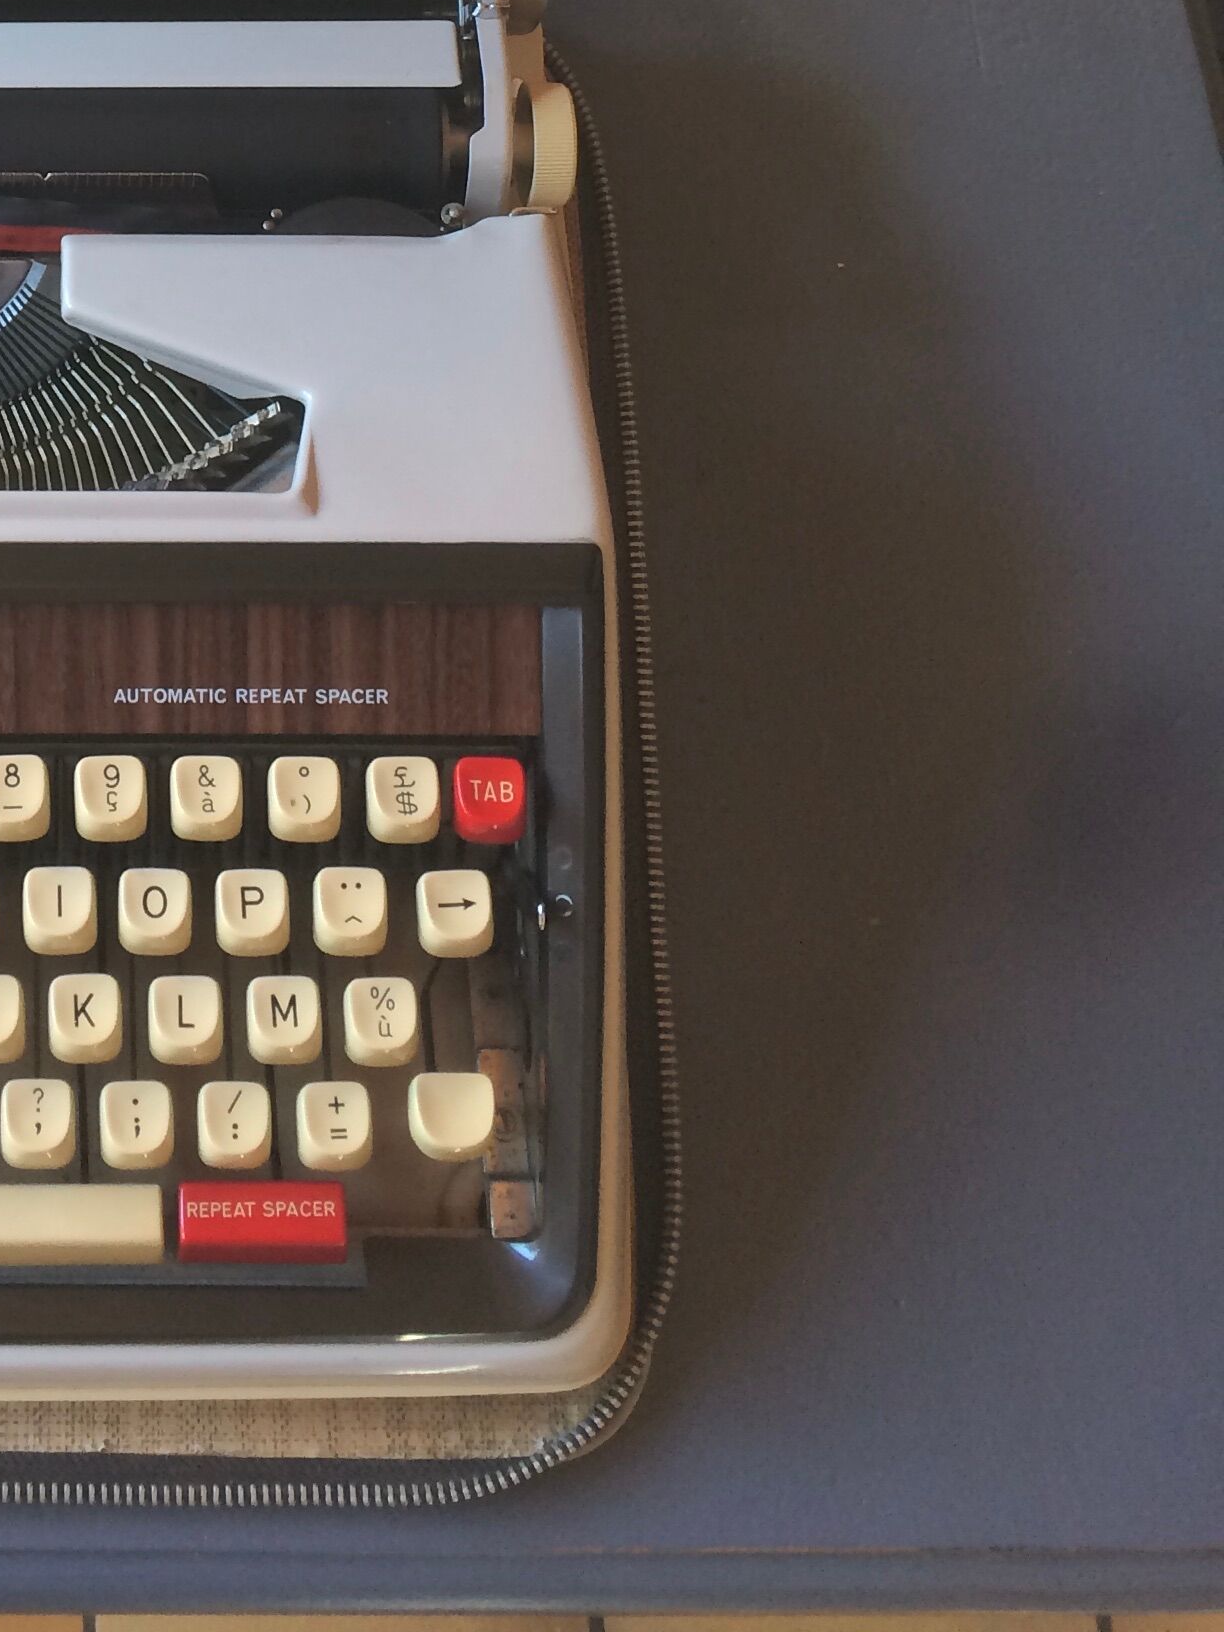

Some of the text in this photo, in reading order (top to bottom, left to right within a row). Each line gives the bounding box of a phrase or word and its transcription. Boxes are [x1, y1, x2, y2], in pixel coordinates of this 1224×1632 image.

[113, 687, 389, 705] AUTOMATIC REPEAT SPACER
[4, 762, 21, 788] 8
[103, 763, 121, 789] 9
[198, 764, 216, 788] &
[106, 790, 118, 813] ç
[201, 791, 216, 813] à
[395, 791, 419, 816] $
[469, 779, 514, 803] TAB
[142, 885, 168, 919] O
[240, 885, 265, 920] P
[73, 992, 95, 1028] K
[270, 993, 298, 1028] M
[369, 985, 396, 1011] %
[177, 994, 195, 1029] L
[377, 1014, 393, 1038] ù
[32, 1087, 45, 1113] ?
[328, 1095, 345, 1115] +
[329, 1128, 348, 1140] =
[186, 1201, 336, 1219] REPEAT SPACER
